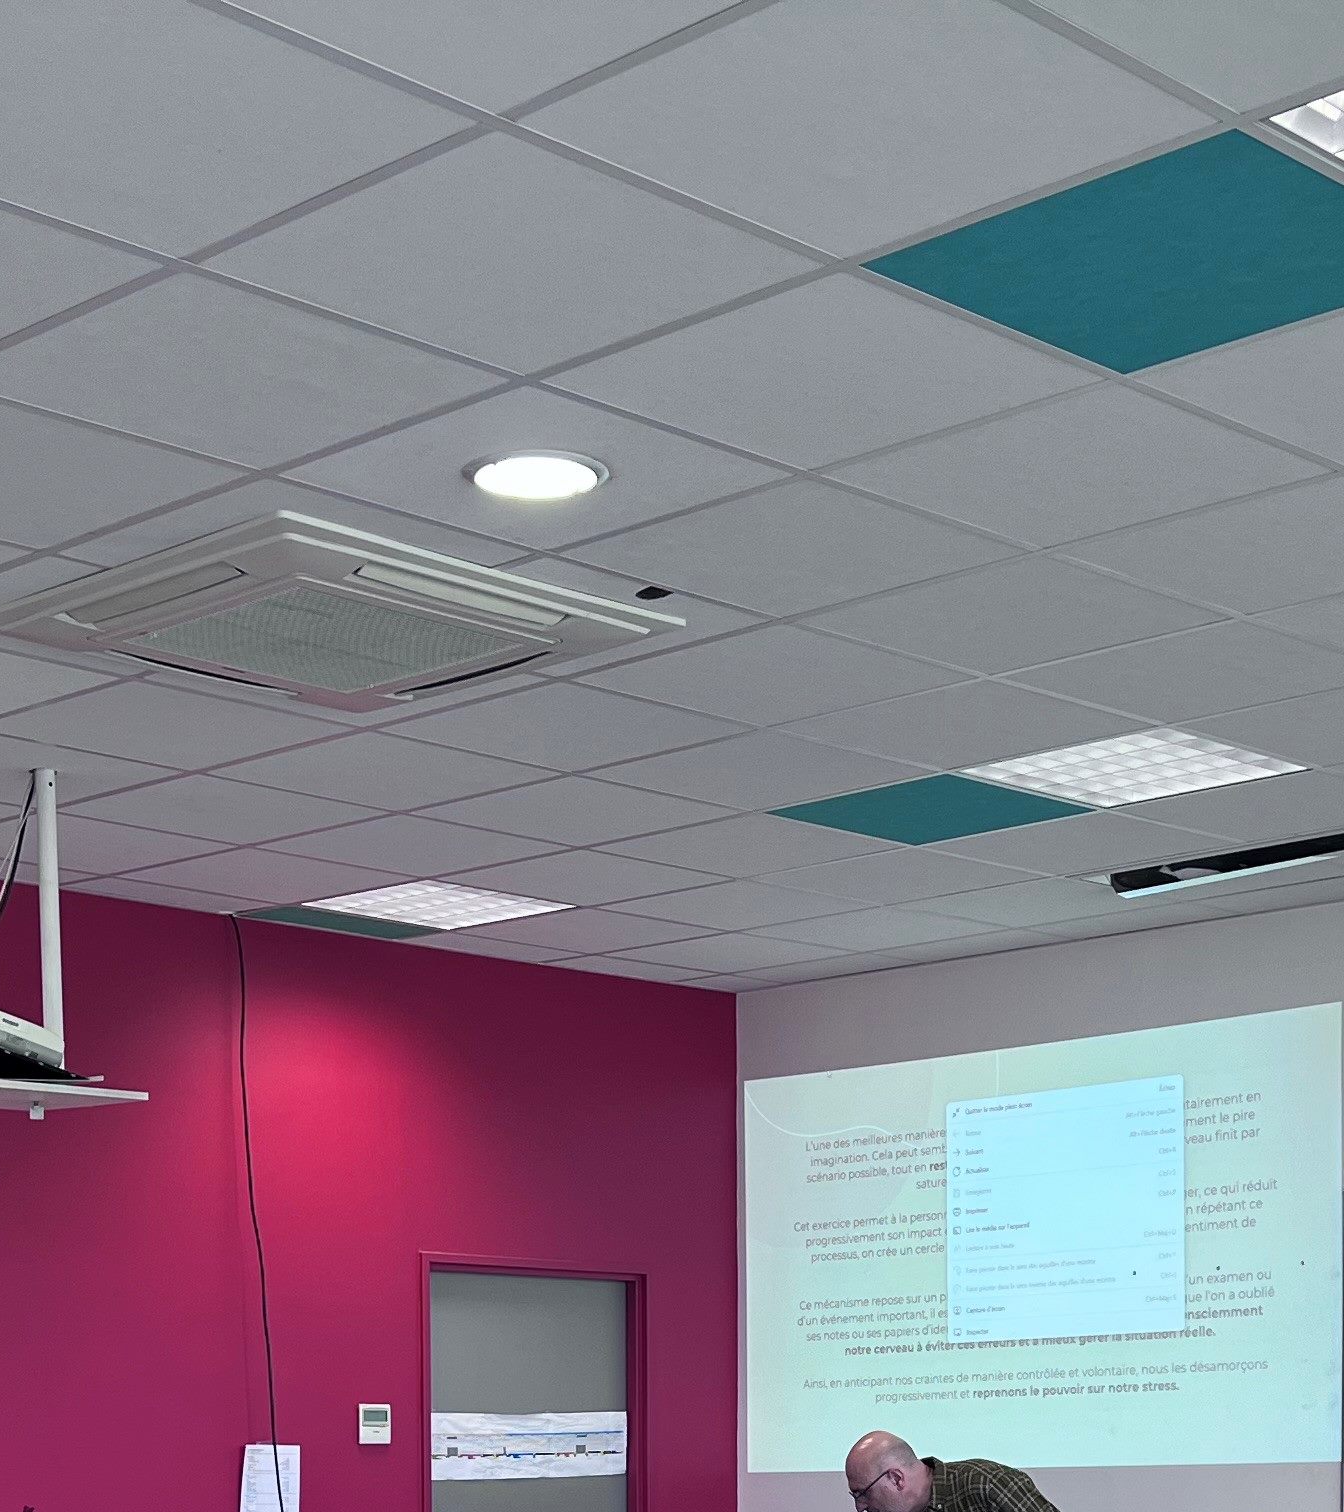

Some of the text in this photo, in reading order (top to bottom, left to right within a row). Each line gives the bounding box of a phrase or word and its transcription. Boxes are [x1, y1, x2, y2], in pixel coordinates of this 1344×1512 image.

[1184, 1092, 1261, 1110] tairement en
[1184, 1110, 1256, 1127] ment le pire
[833, 1139, 850, 1149] des
[853, 1134, 902, 1146] meilleures
[1215, 1129, 1238, 1141] finit
[1241, 1128, 1260, 1141] par
[810, 1147, 918, 1168] imagination. Cela peut
[806, 1171, 846, 1184] scénario
[848, 1167, 890, 1181] possible,
[891, 1164, 913, 1176] tout
[914, 1164, 927, 1173] en
[1204, 1178, 1278, 1197] ce qui réduit
[1196, 1200, 1263, 1216] répétant ce
[812, 1219, 851, 1231] exercice
[853, 1216, 888, 1229] permet
[891, 1213, 897, 1225] à
[899, 1213, 907, 1223] la
[1241, 1216, 1256, 1228] de
[805, 1227, 942, 1249] progressivement son impact
[811, 1243, 945, 1264] processus, on crée un cercle
[1206, 1270, 1272, 1284] examen ou
[799, 1294, 937, 1311] Ce mécanisme repose sur un
[1205, 1287, 1275, 1301] l'on a oublié
[797, 1316, 819, 1327] d'un
[820, 1312, 875, 1326] événement
[876, 1309, 928, 1323] important,
[930, 1309, 936, 1319] il
[806, 1325, 920, 1342] ses notes ou ses papiers
[844, 1345, 872, 1357] notre
[873, 1343, 914, 1355] cerveau
[916, 1341, 923, 1353] à
[925, 1338, 956, 1352] éviter
[977, 1337, 1016, 1349] erreurs
[1179, 1326, 1216, 1339] réelle.
[803, 1359, 1268, 1391] Ainsi, en anticipant nos craintes de manière contrôlée et volontaire, nous les désamorçons
[875, 1380, 1180, 1404] progressivement et reprenons le pouvoir sur notre stress.
